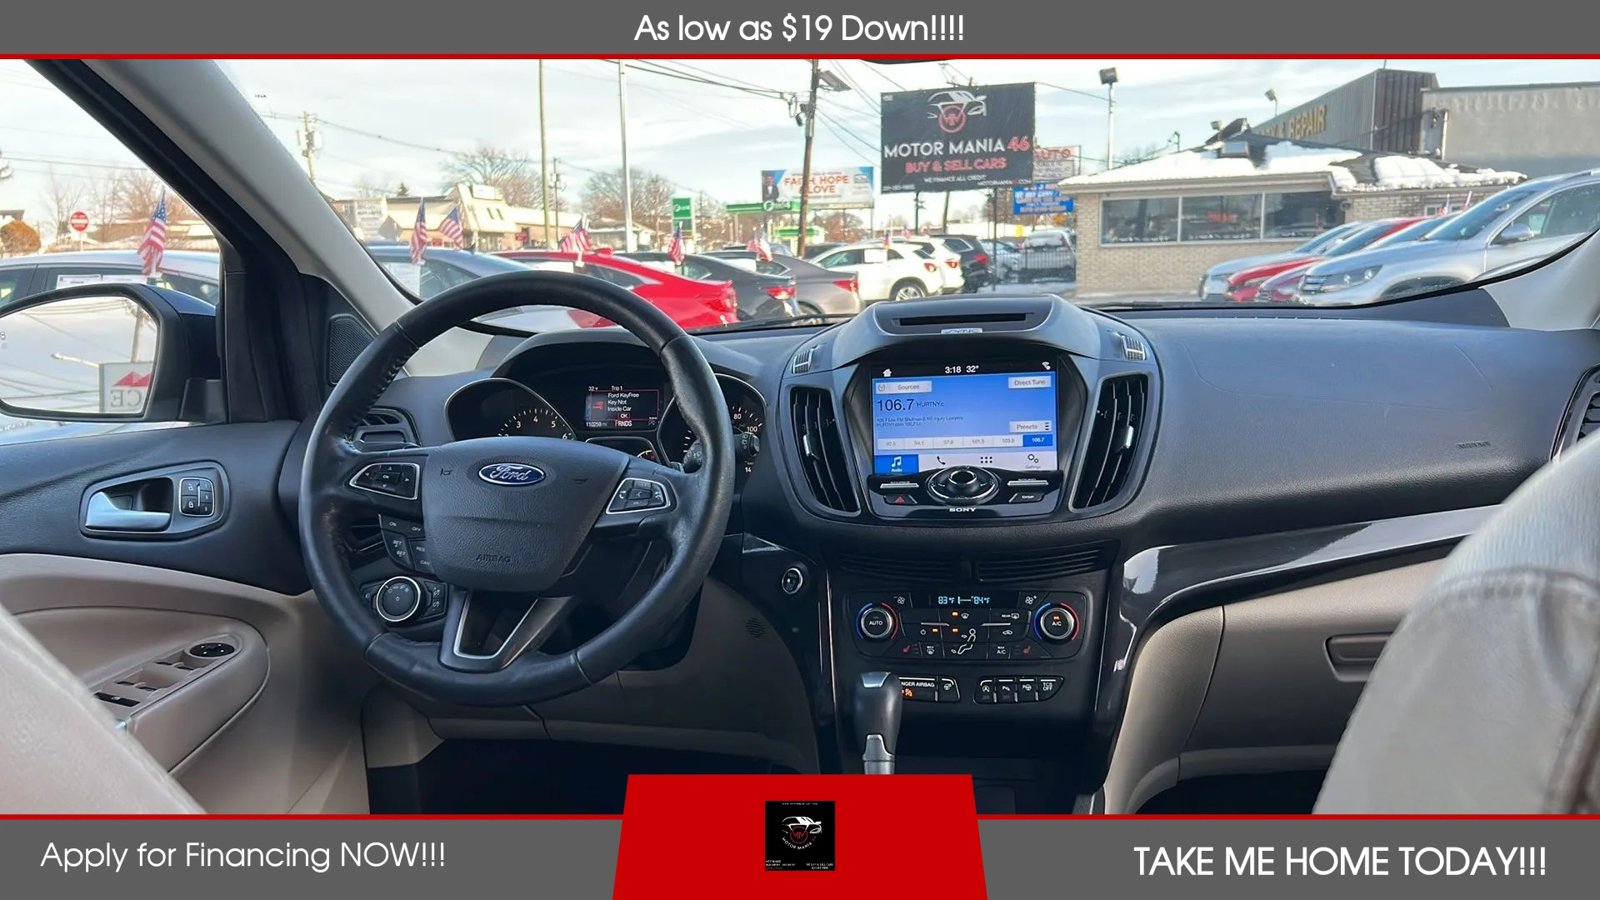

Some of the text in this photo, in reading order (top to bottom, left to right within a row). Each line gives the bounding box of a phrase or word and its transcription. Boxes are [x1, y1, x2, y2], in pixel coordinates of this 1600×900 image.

[1290, 104, 1327, 141] REPAIR
[884, 136, 1031, 158] MOTOR MANIA 46
[905, 160, 930, 174] BUY
[944, 158, 973, 171] SELL
[974, 157, 1008, 170] CARS
[821, 175, 850, 185] HOPE
[807, 185, 836, 194] LOVE
[945, 366, 962, 374] 3:18
[877, 399, 914, 411] 106.7
[489, 465, 531, 482] Ford
